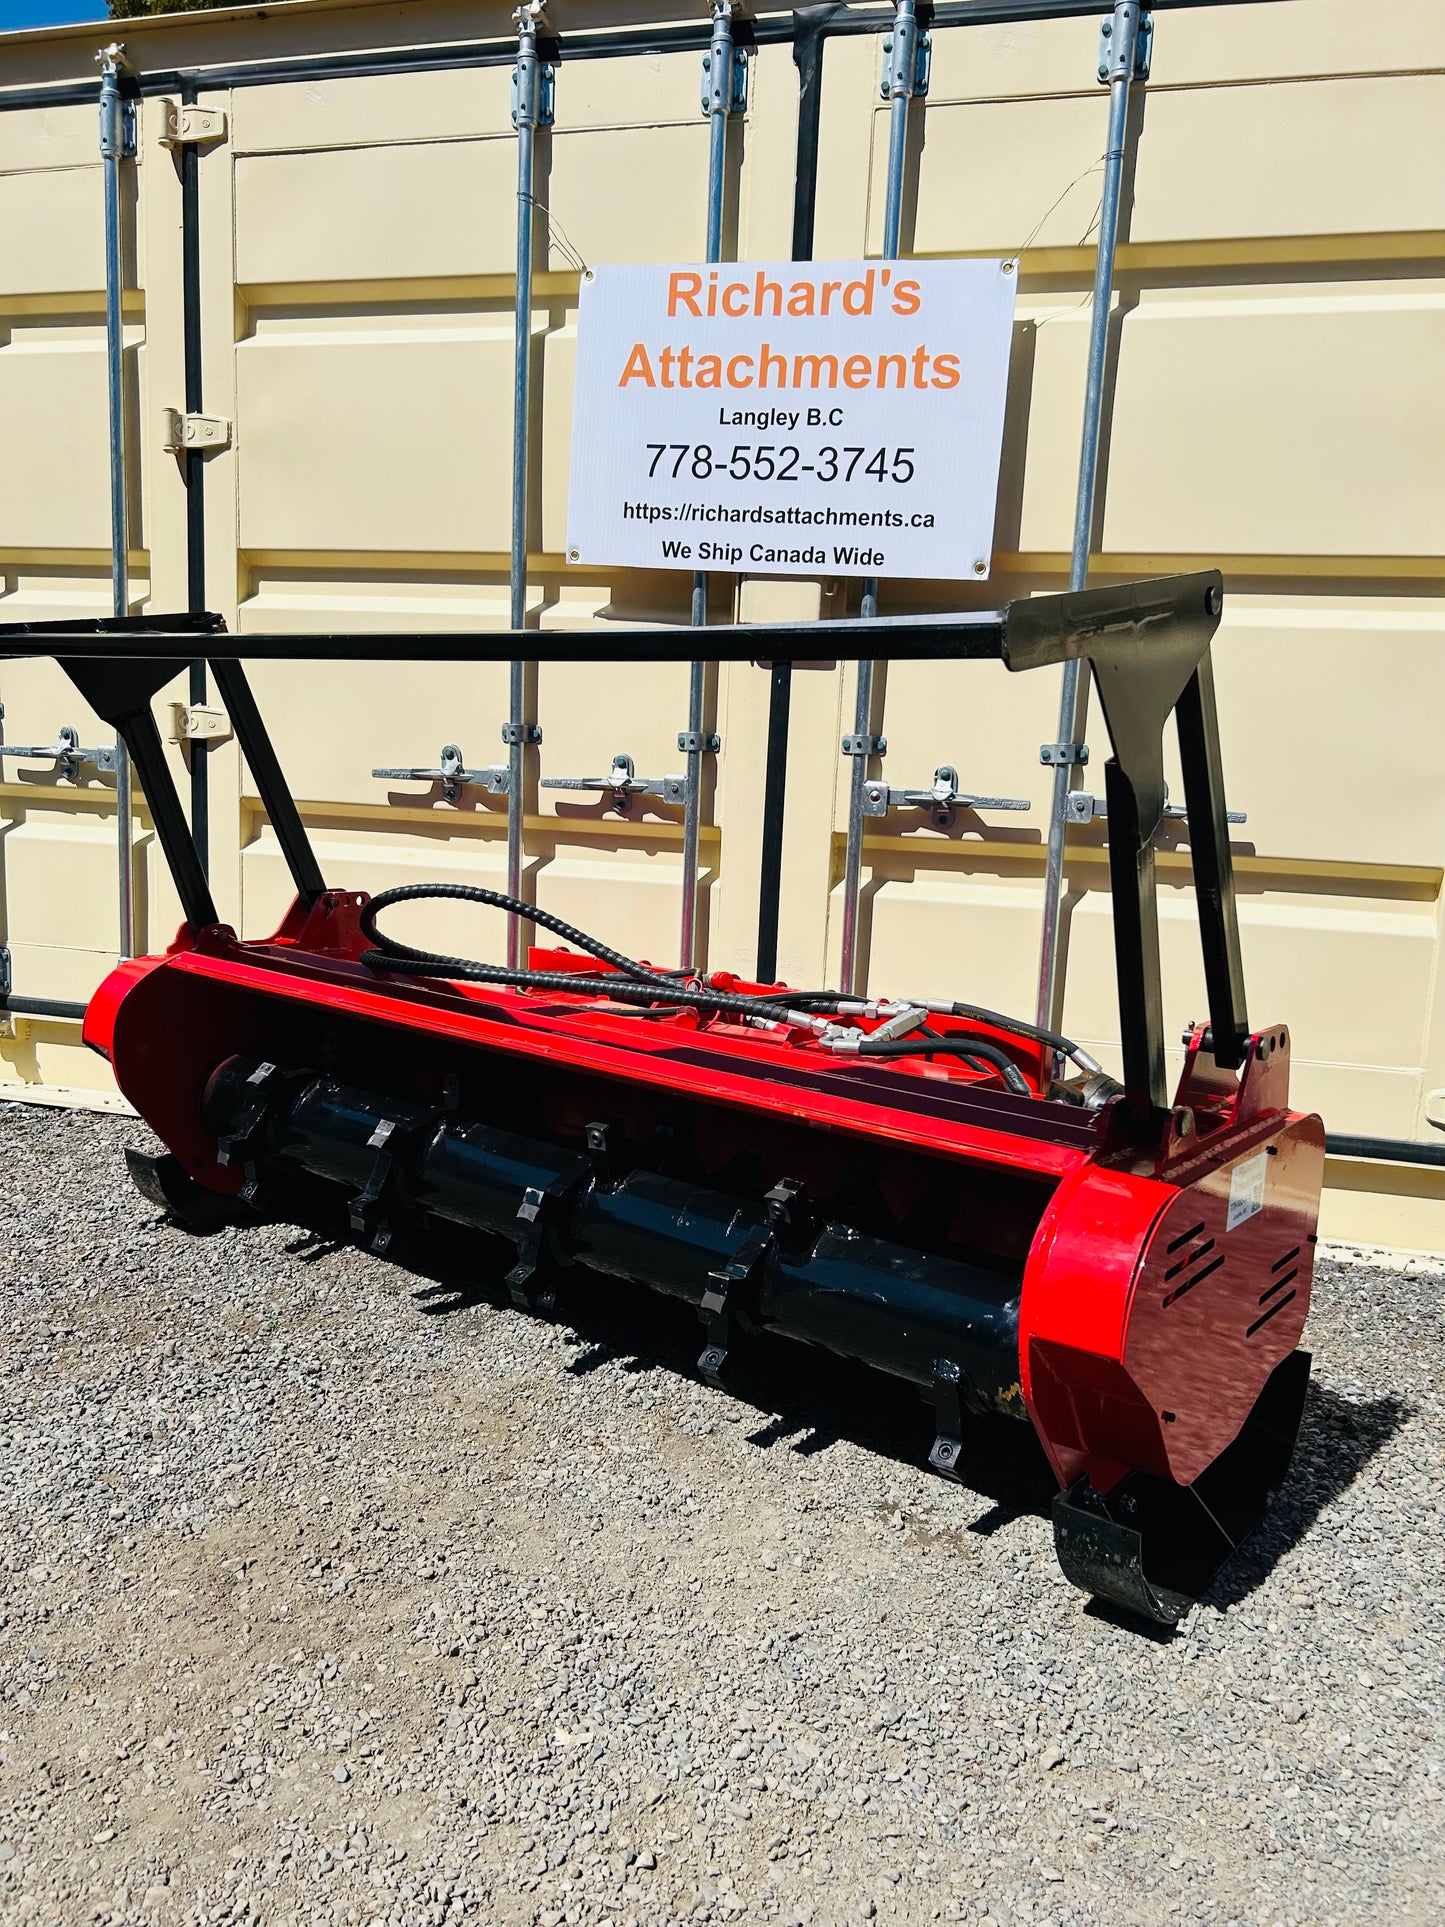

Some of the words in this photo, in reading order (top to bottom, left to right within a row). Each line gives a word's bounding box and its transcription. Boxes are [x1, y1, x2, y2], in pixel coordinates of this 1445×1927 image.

[667, 268, 921, 317] Richard's
[618, 343, 961, 390] Attachments
[719, 407, 800, 430] Langley
[806, 407, 844, 427] B.C
[646, 443, 915, 484] 778-552-3745
[623, 501, 935, 528] https://richardsattachments.ca
[661, 540, 692, 560] We
[697, 542, 743, 566] Ship
[749, 544, 826, 564] Canada
[833, 546, 885, 566] Wide
